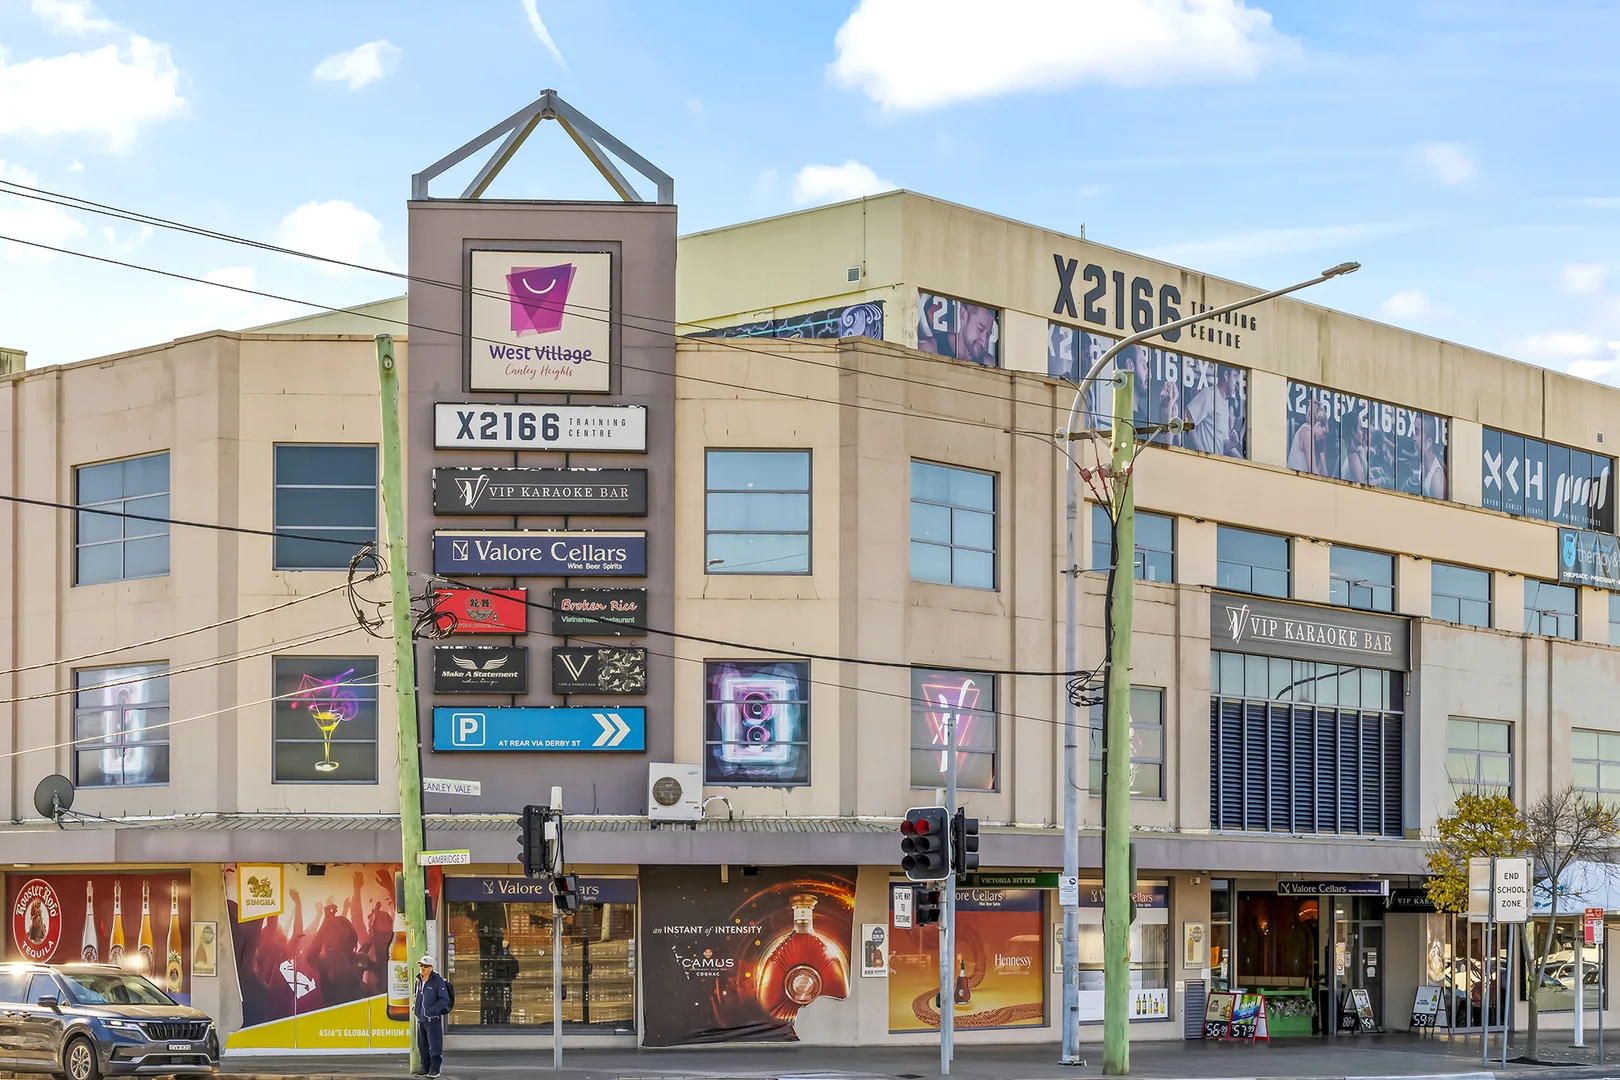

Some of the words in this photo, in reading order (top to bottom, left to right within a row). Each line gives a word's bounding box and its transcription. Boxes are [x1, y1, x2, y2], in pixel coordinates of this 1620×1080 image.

[1053, 253, 1181, 343] X2166
[1191, 300, 1256, 331] TRAINING
[1191, 323, 1240, 349] CENTRE
[489, 344, 531, 360] West
[535, 345, 593, 365] Village
[504, 363, 537, 380] Canley
[540, 363, 574, 381] Heights
[456, 411, 560, 441] X2166
[569, 417, 627, 428] TRAINING
[568, 428, 613, 438] CENTRE
[489, 486, 515, 498] VIP
[521, 486, 593, 498] KARAOKE
[600, 486, 629, 498] BAR
[474, 540, 542, 561] Valore
[550, 541, 627, 562] Cellars
[567, 562, 583, 570] Wine
[586, 562, 601, 570] Beer
[602, 562, 623, 571] Spirits
[561, 598, 607, 612] Broken
[610, 599, 638, 612] Rice
[1250, 616, 1278, 637] VIP
[1284, 621, 1358, 648] KARAOKE
[1364, 632, 1392, 652] BAR
[557, 654, 593, 681] V
[441, 670, 464, 678] Make
[464, 670, 473, 678] A
[473, 670, 519, 678] Statement
[545, 740, 571, 748] DERBY
[423, 782, 451, 792] CANLEY
[454, 784, 471, 794] VALE
[427, 855, 460, 864] CAMBRIDGE
[461, 854, 467, 863] ST
[1504, 872, 1519, 880] END
[498, 880, 543, 895] Valore
[548, 882, 600, 895] Cars
[1291, 883, 1317, 893] Valore
[1318, 883, 1347, 893] Cellars
[1497, 886, 1526, 894] SCHOOL
[15, 885, 44, 917] Rooster
[42, 886, 58, 917] Rojo
[955, 892, 969, 901] ore
[972, 889, 1003, 901] Cellars
[1132, 892, 1154, 903] ellars
[1413, 897, 1434, 905] KARA
[1501, 899, 1522, 908] ZONE
[664, 925, 703, 934] INSTANT
[704, 926, 713, 937] of
[715, 925, 762, 934] INTENSITY
[22, 940, 54, 959] TEQUILA
[681, 958, 735, 968] CAMUS
[994, 953, 1032, 969] Hennessy
[319, 1028, 342, 1037] ASIA'S
[343, 1028, 370, 1037] GLOBAL
[372, 1028, 404, 1037] PREMIUM
